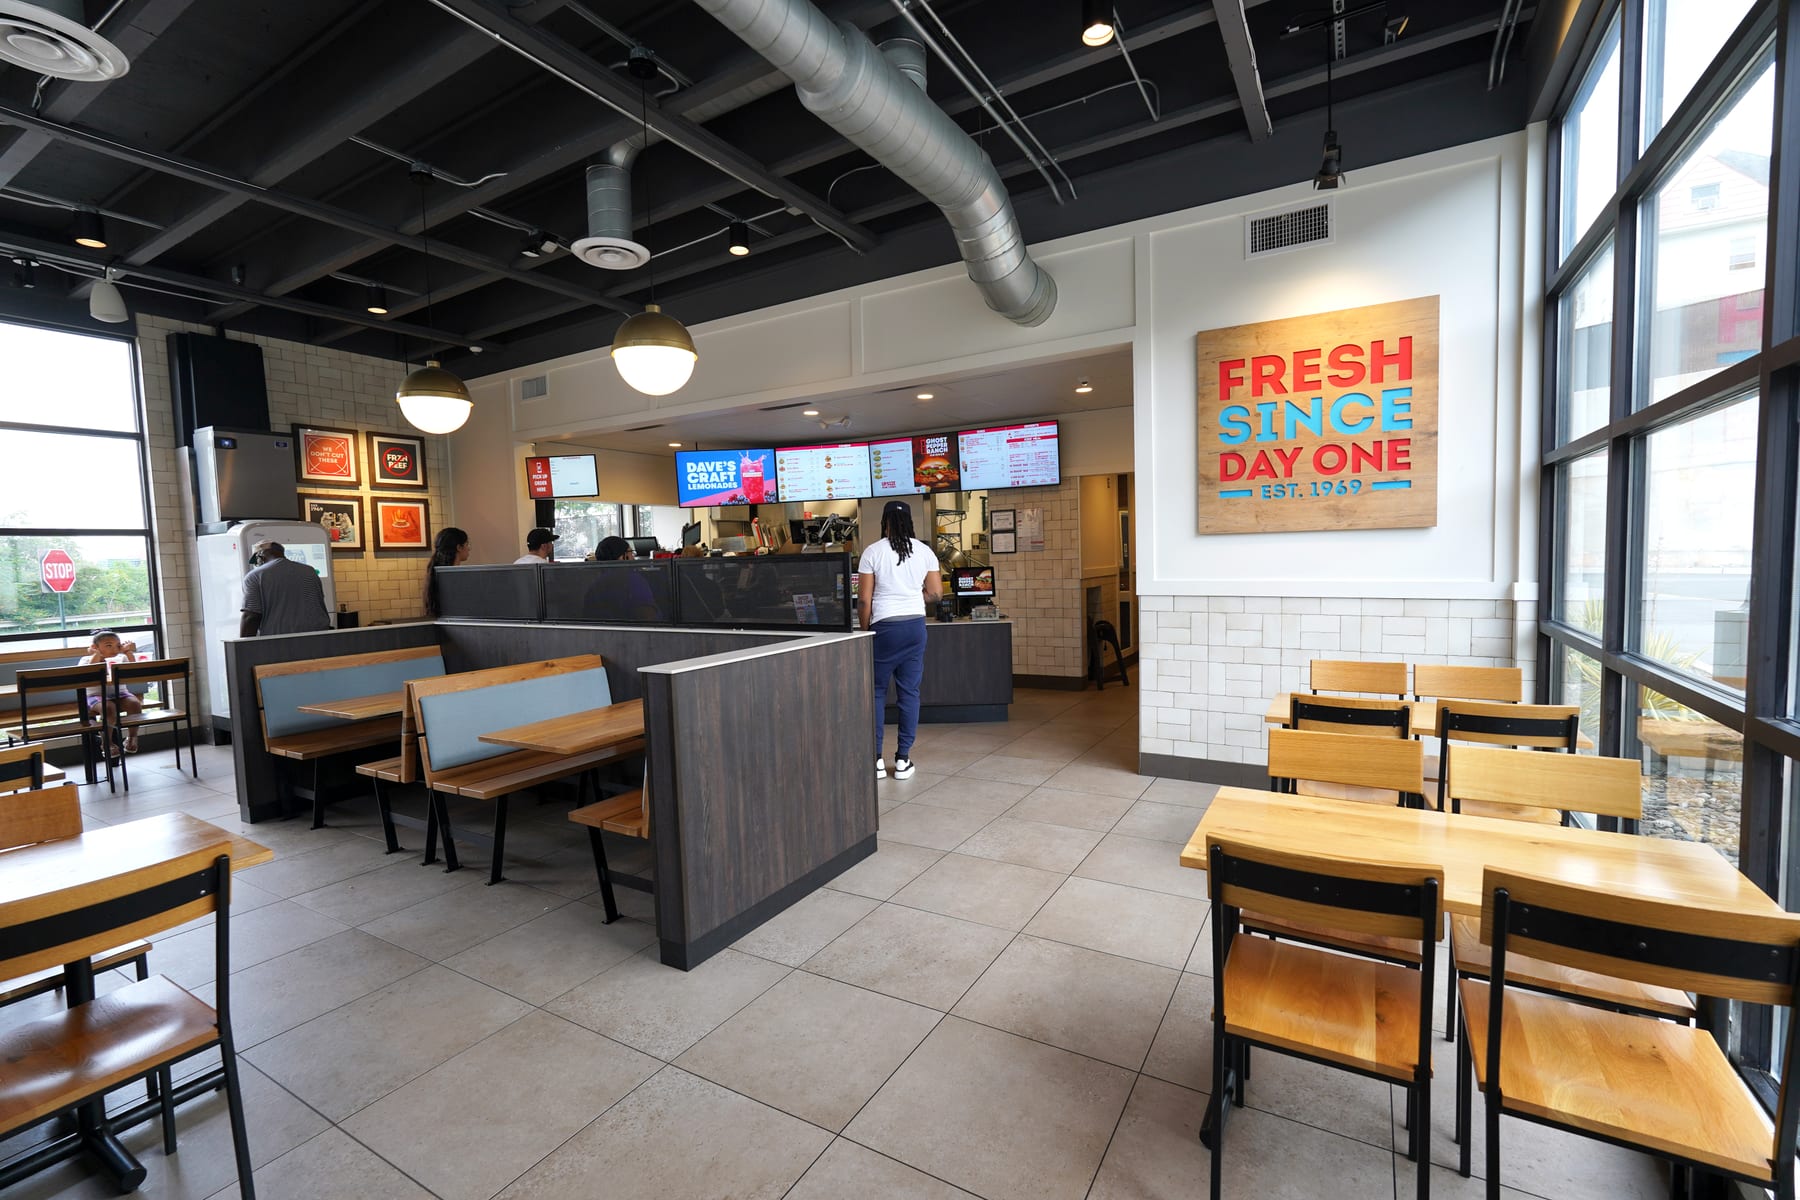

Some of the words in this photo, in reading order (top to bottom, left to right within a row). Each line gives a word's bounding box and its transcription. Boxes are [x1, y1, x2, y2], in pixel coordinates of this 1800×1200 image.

[1218, 336, 1413, 401] FRESH
[1218, 387, 1413, 445] SINCE
[926, 447, 949, 455] RANCH
[686, 461, 737, 473] DAVE'S
[1219, 447, 1304, 482] DAY
[1312, 438, 1411, 476] ONE
[687, 472, 736, 484] CRAFT
[687, 482, 738, 491] LEMONADES
[1260, 483, 1304, 500] EST.
[1309, 479, 1363, 498] 1969
[45, 562, 73, 579] STOP
